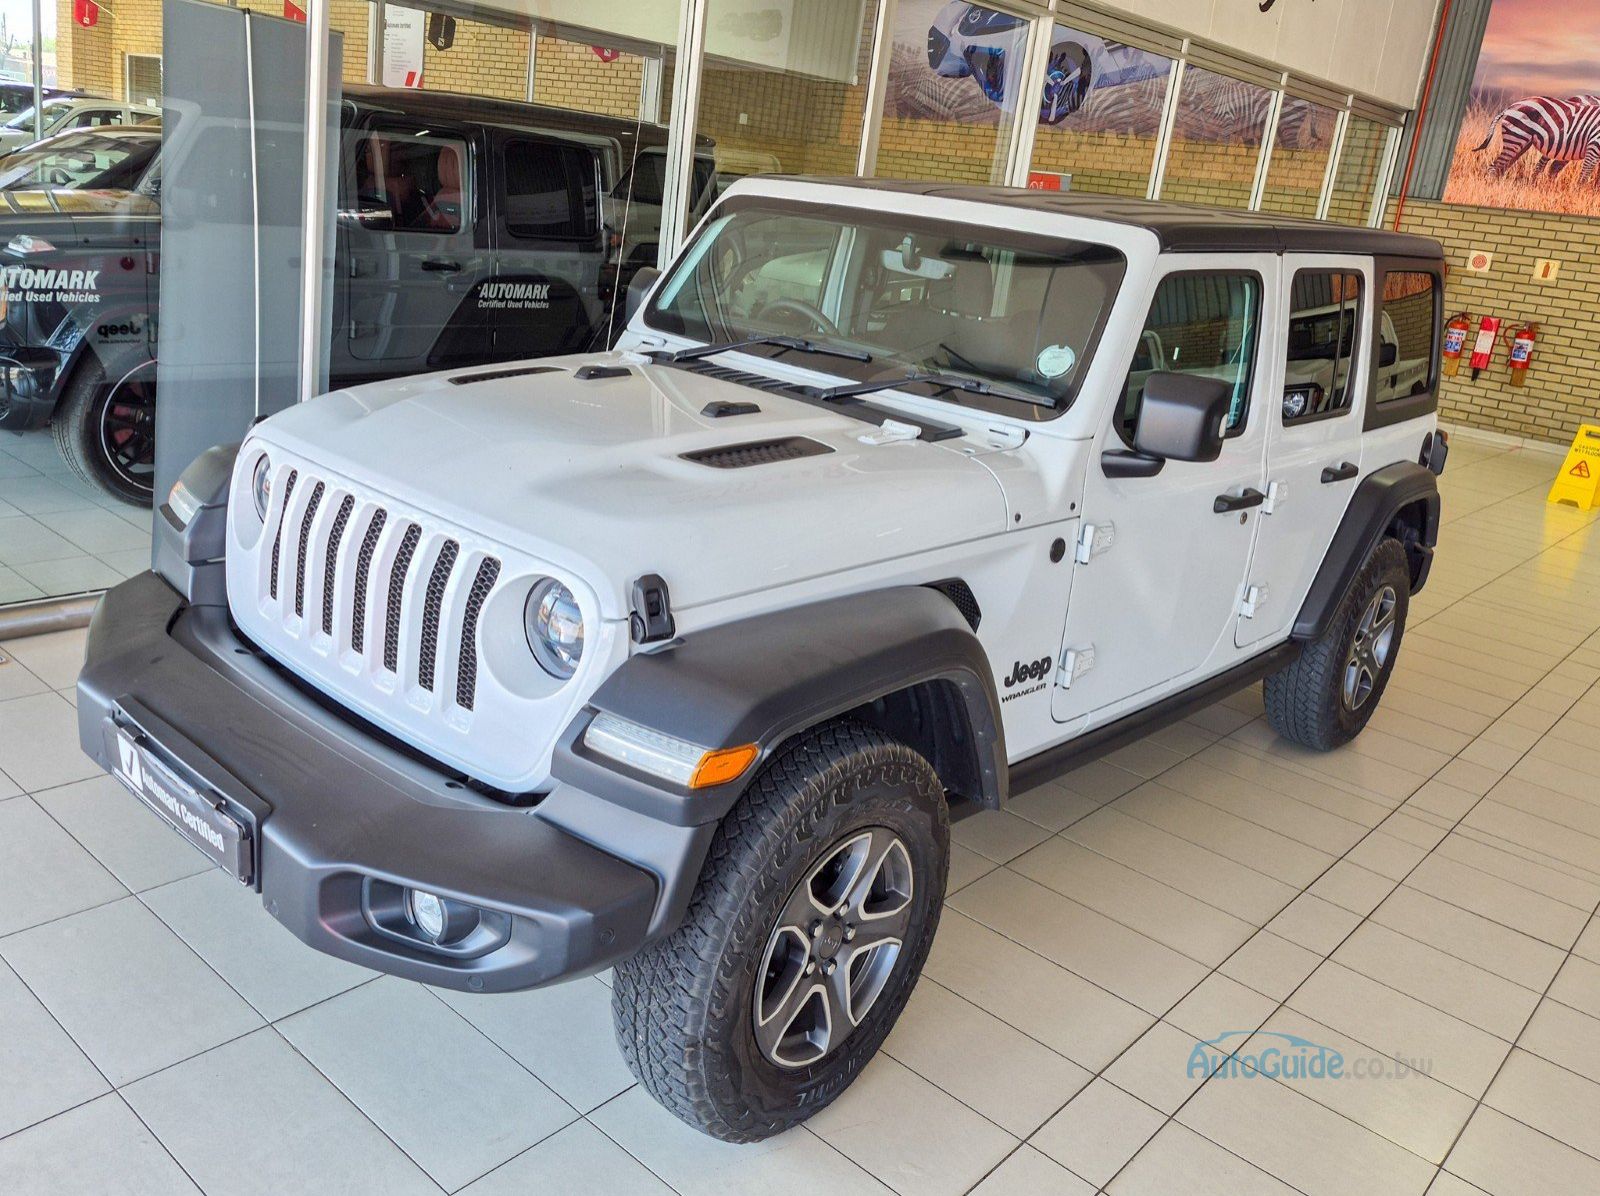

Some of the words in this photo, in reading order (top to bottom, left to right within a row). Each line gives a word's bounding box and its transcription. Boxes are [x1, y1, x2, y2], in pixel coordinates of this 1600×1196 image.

[26, 291, 52, 302] Used
[56, 292, 101, 303] Vehicles
[479, 283, 550, 299] AUTOMARK
[478, 300, 506, 309] Certified
[507, 300, 523, 309] Used
[524, 301, 549, 309] Vehicles
[1004, 656, 1052, 688] Jeep
[180, 804, 225, 853] Certified
